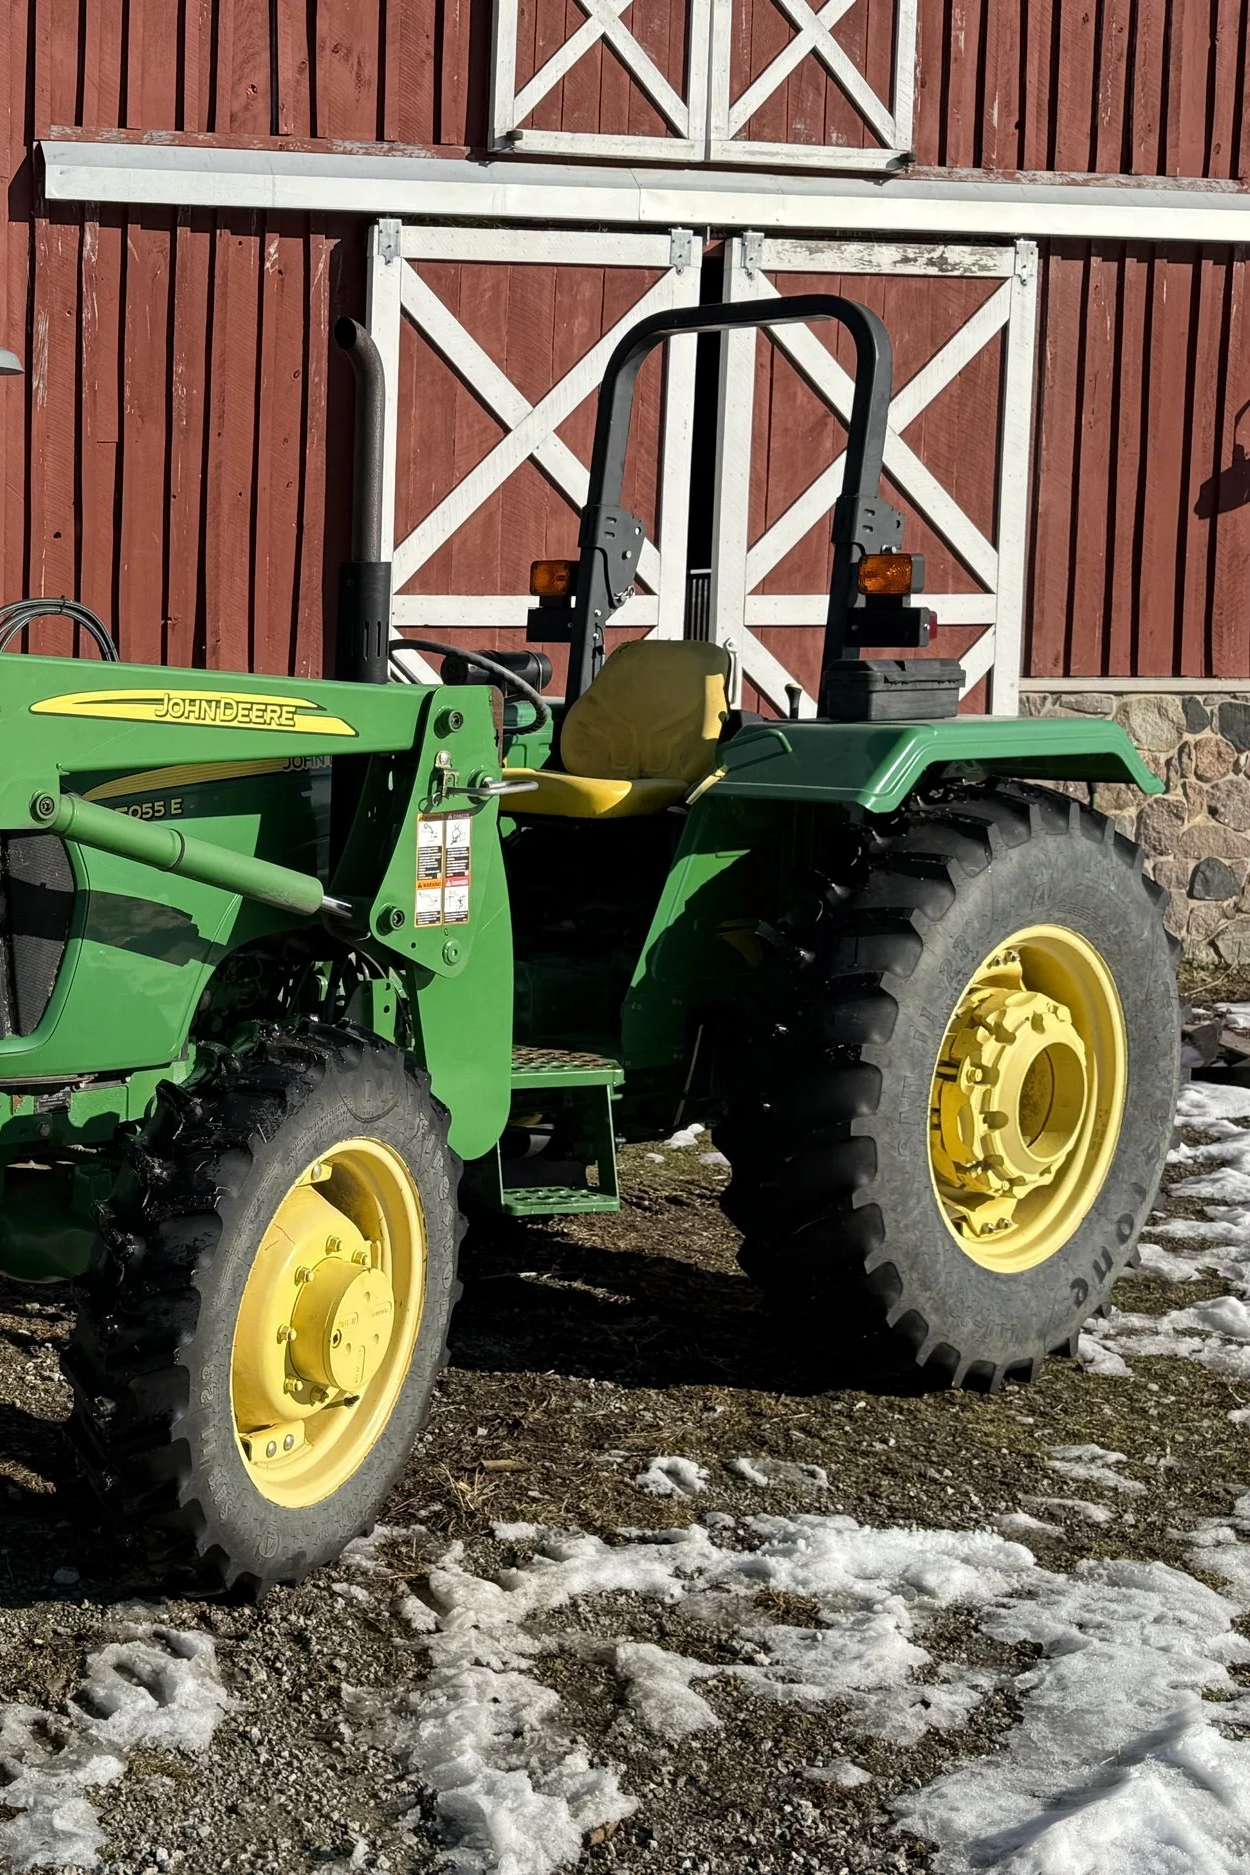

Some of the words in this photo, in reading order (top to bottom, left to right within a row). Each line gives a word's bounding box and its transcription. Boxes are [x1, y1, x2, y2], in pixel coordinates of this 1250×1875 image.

[154, 692, 218, 721] JOHN
[219, 696, 296, 728] DEERE
[115, 801, 165, 819] 055
[171, 798, 182, 815] E
